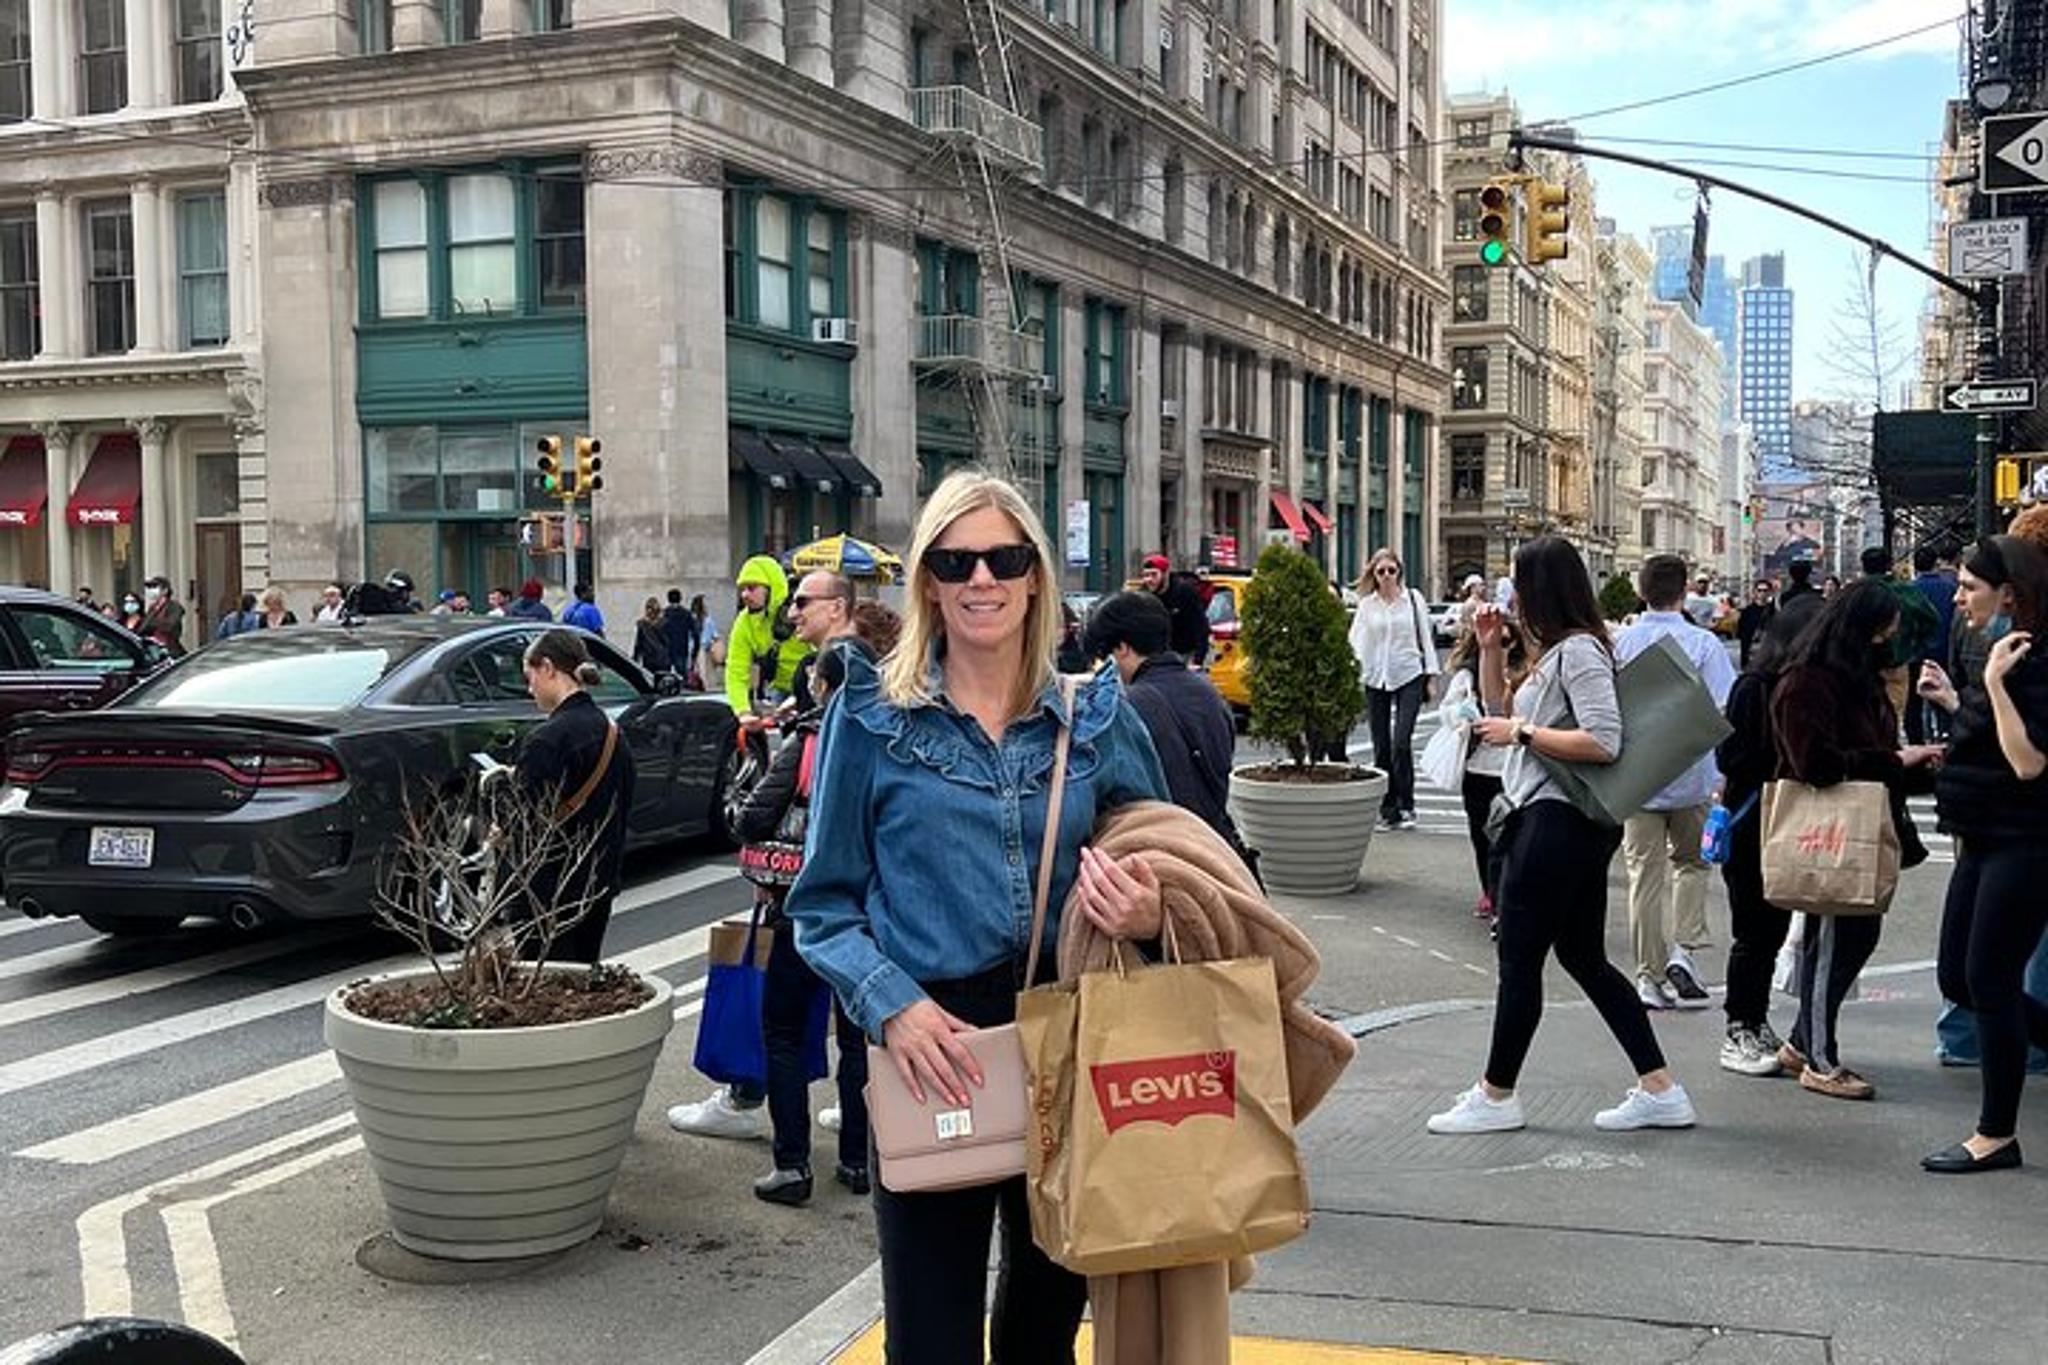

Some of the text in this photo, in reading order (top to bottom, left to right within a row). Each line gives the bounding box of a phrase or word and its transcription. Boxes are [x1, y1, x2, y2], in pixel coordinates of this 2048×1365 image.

[1954, 224, 2020, 237] DON'T BLOCK
[1966, 236, 2010, 246] THE BOX
[1956, 390, 2023, 403] ONE WAY
